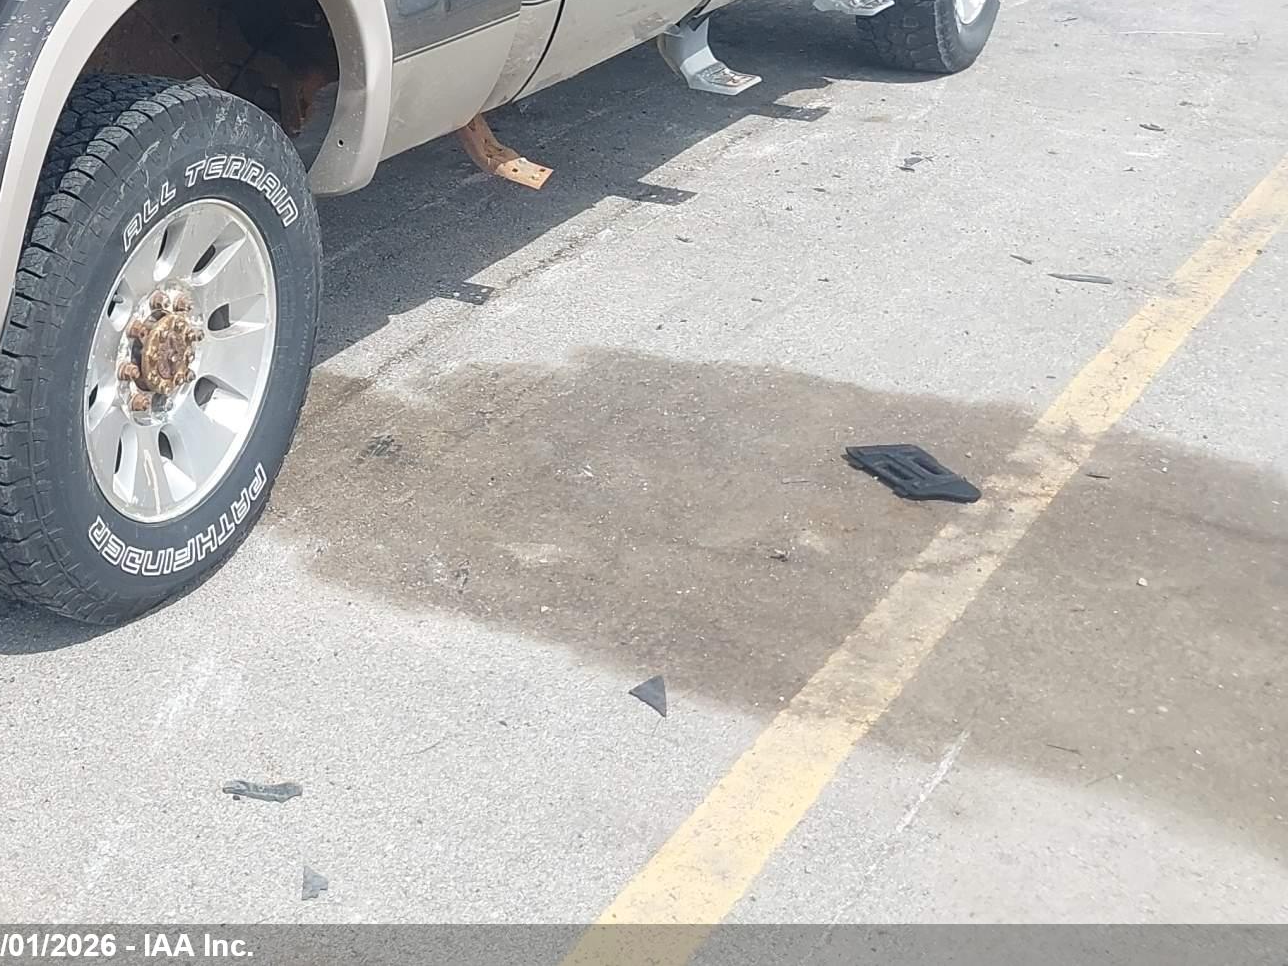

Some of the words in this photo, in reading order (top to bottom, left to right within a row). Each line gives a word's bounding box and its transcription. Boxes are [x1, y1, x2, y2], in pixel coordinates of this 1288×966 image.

[123, 180, 177, 252] ALL
[184, 153, 300, 227] TERRAIN
[88, 462, 268, 576] PATHFINDER
